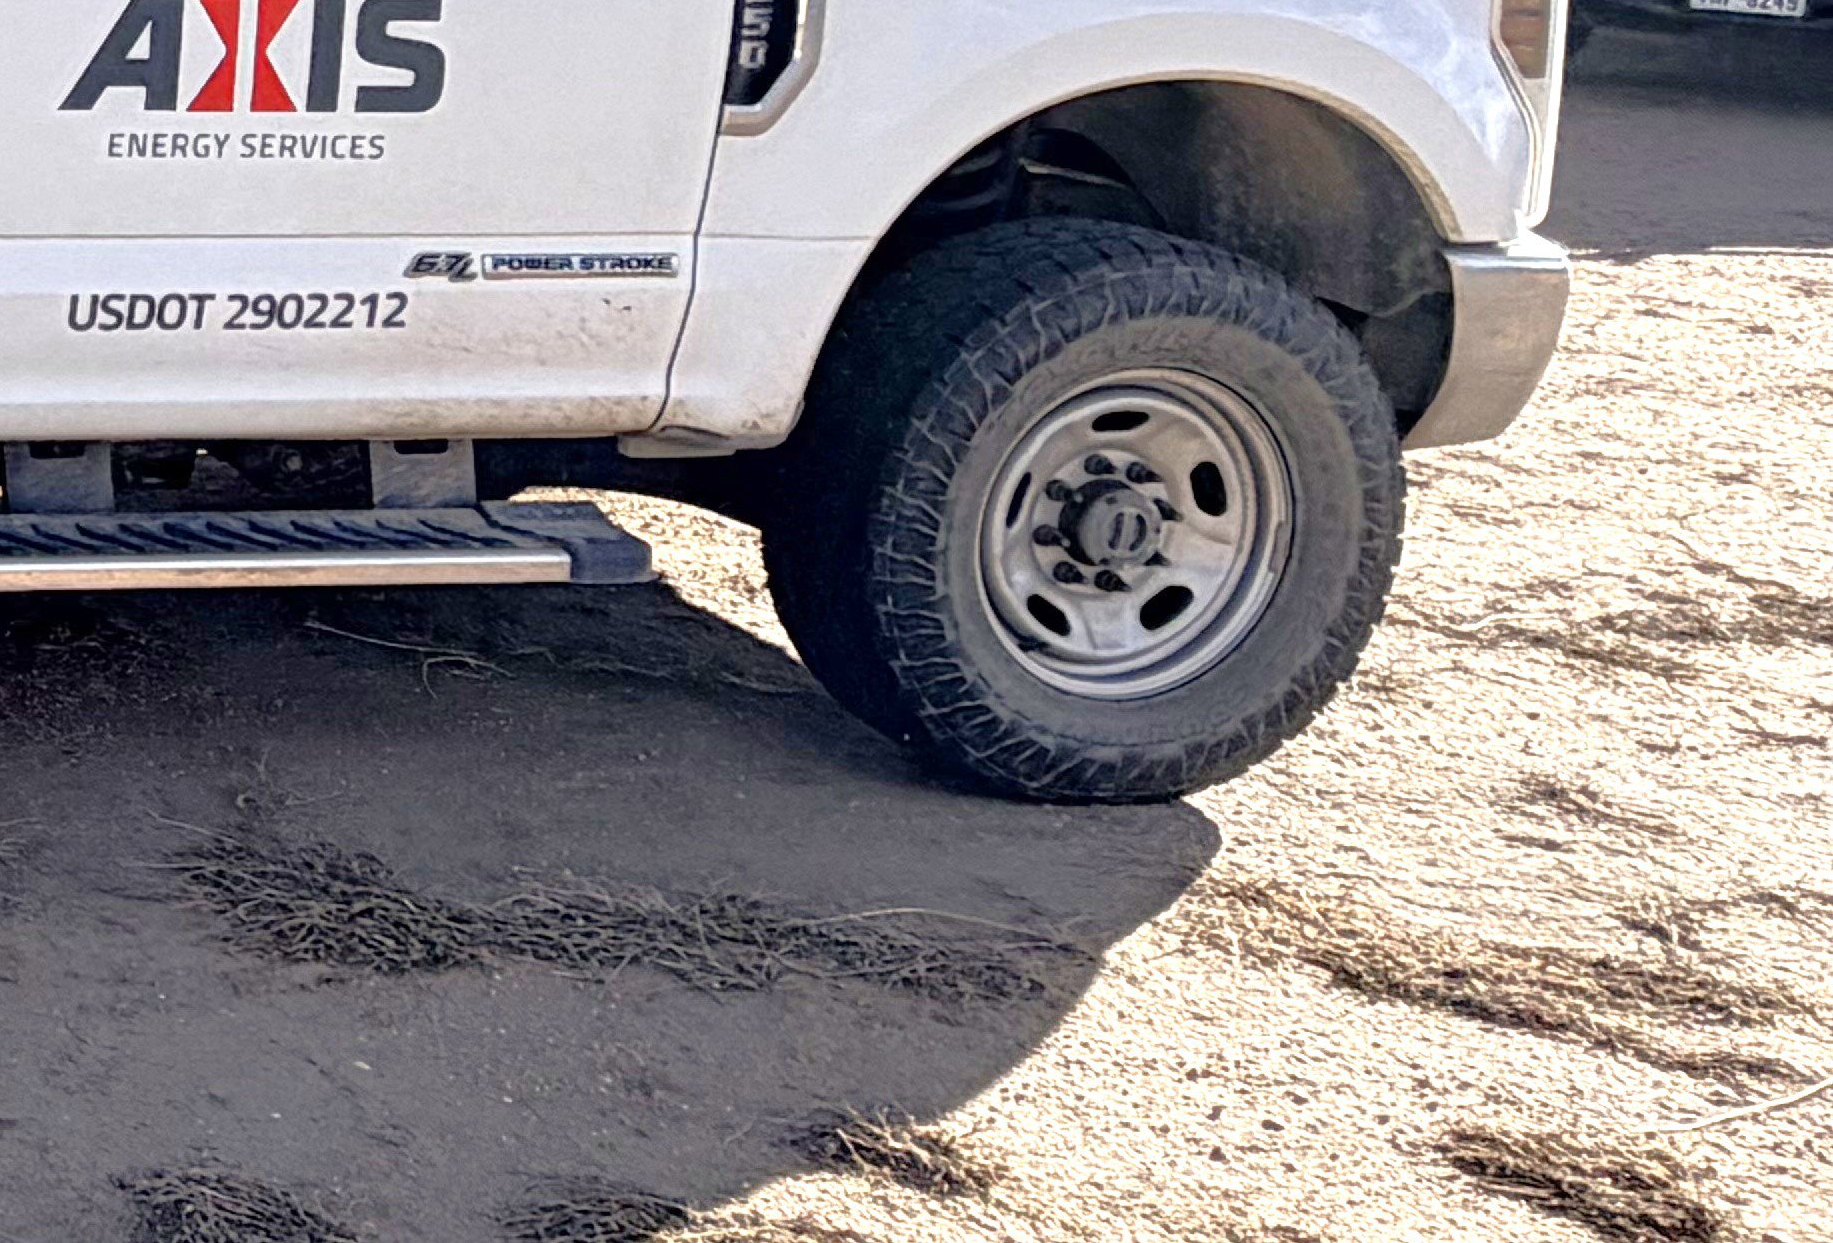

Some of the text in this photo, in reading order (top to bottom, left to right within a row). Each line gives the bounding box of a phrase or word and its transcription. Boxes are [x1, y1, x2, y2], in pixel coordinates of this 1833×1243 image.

[108, 132, 386, 160] ENERGY SERVICES
[491, 255, 573, 271] POWER
[579, 255, 674, 271] STROKE
[68, 290, 410, 331] USDOT 2902212
